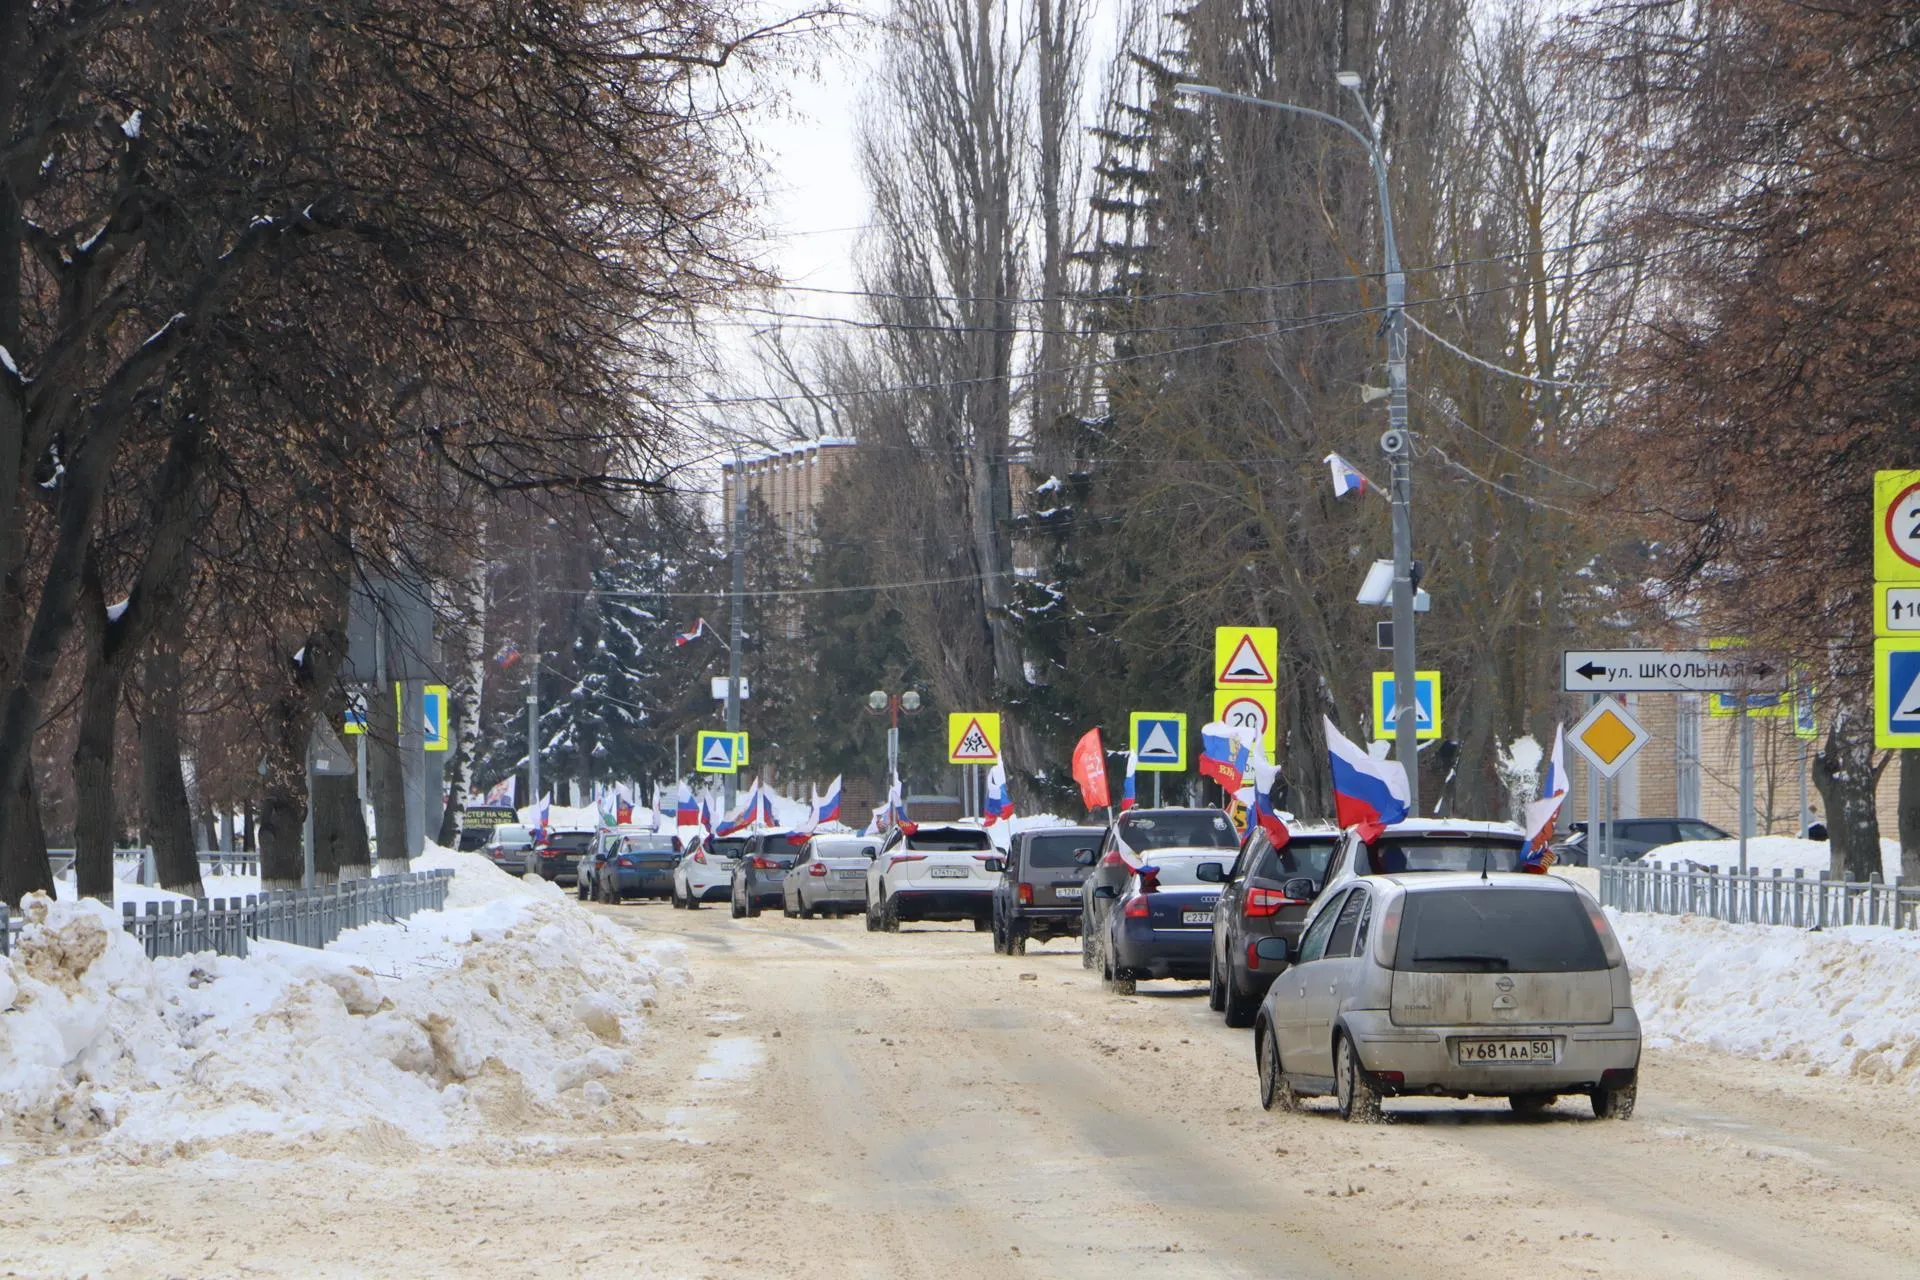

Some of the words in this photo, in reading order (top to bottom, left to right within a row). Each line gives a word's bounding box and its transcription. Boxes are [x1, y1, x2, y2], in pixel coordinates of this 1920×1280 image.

[1908, 508, 1920, 539] 2
[1607, 667, 1633, 682] ул.
[1639, 663, 1746, 678] ШКОЛЬНАЯ
[1233, 712, 1257, 728] 20
[1465, 1043, 1529, 1059] У681АА
[1532, 1042, 1549, 1054] 50
